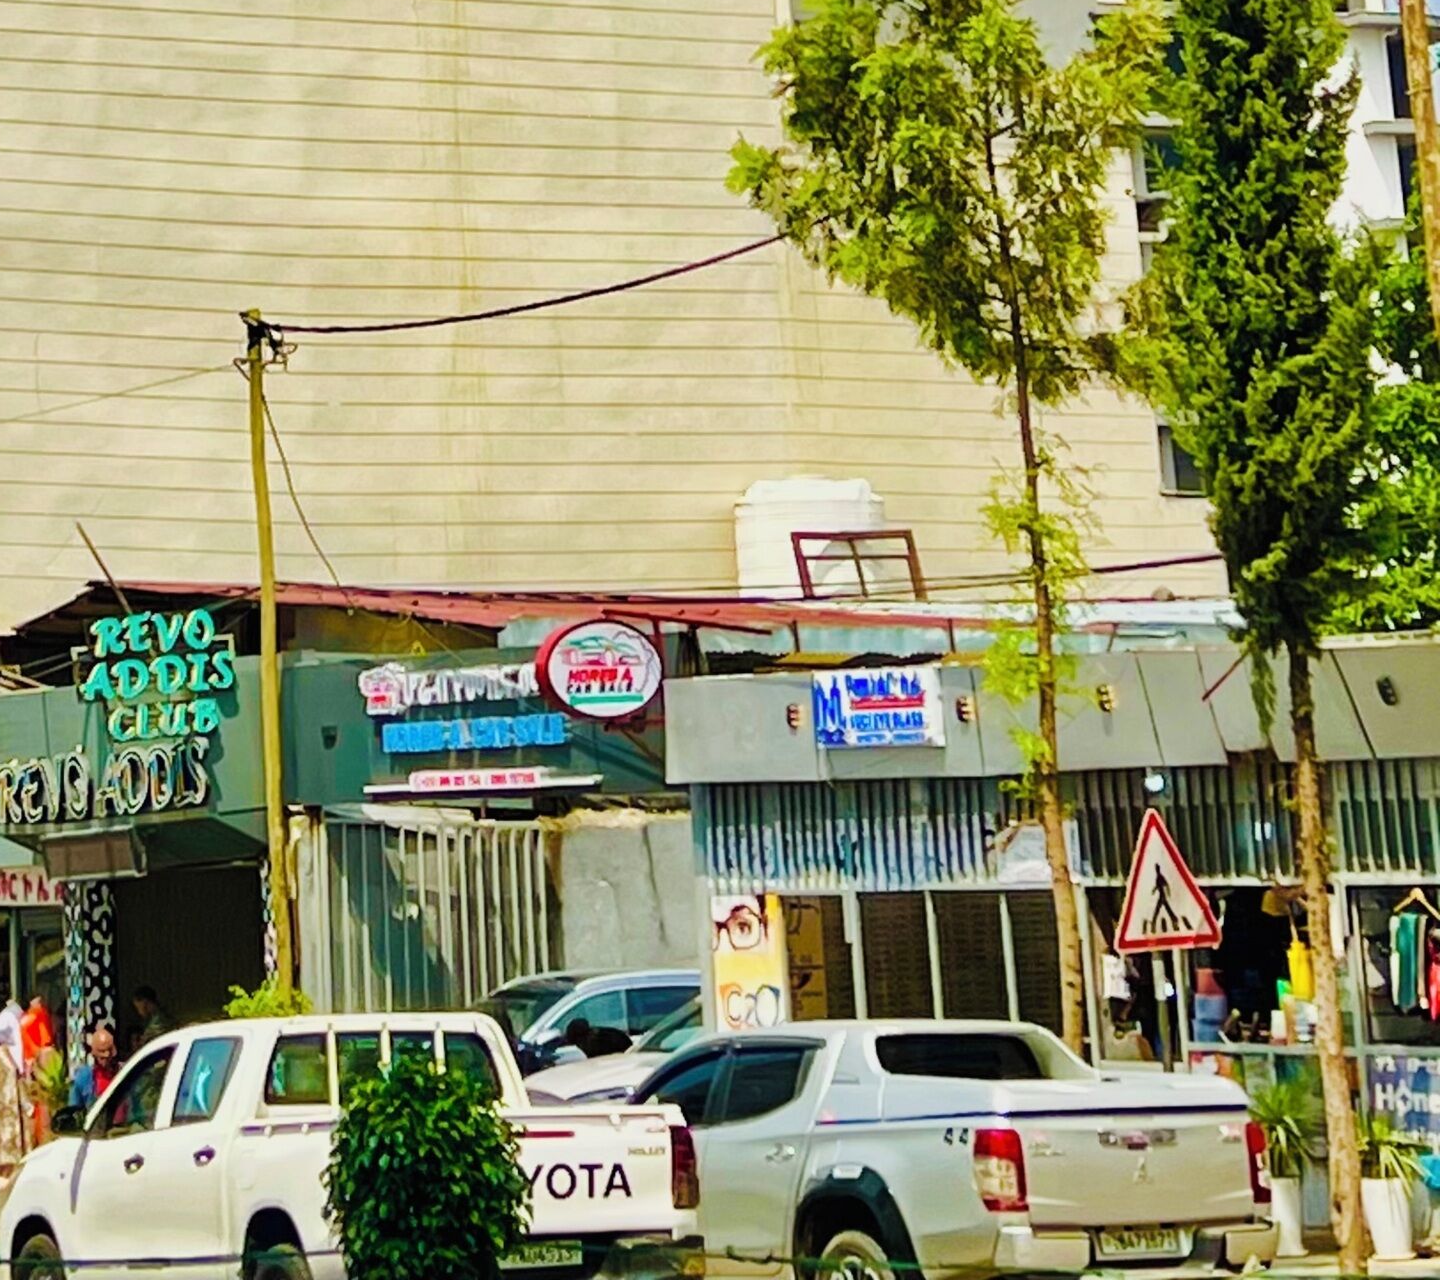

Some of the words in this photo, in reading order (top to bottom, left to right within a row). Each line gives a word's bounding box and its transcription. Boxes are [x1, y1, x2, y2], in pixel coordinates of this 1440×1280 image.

[89, 608, 216, 657] REVO
[79, 650, 237, 701] ADDIS
[108, 698, 220, 741] CLUB
[97, 736, 210, 817] ADDIS
